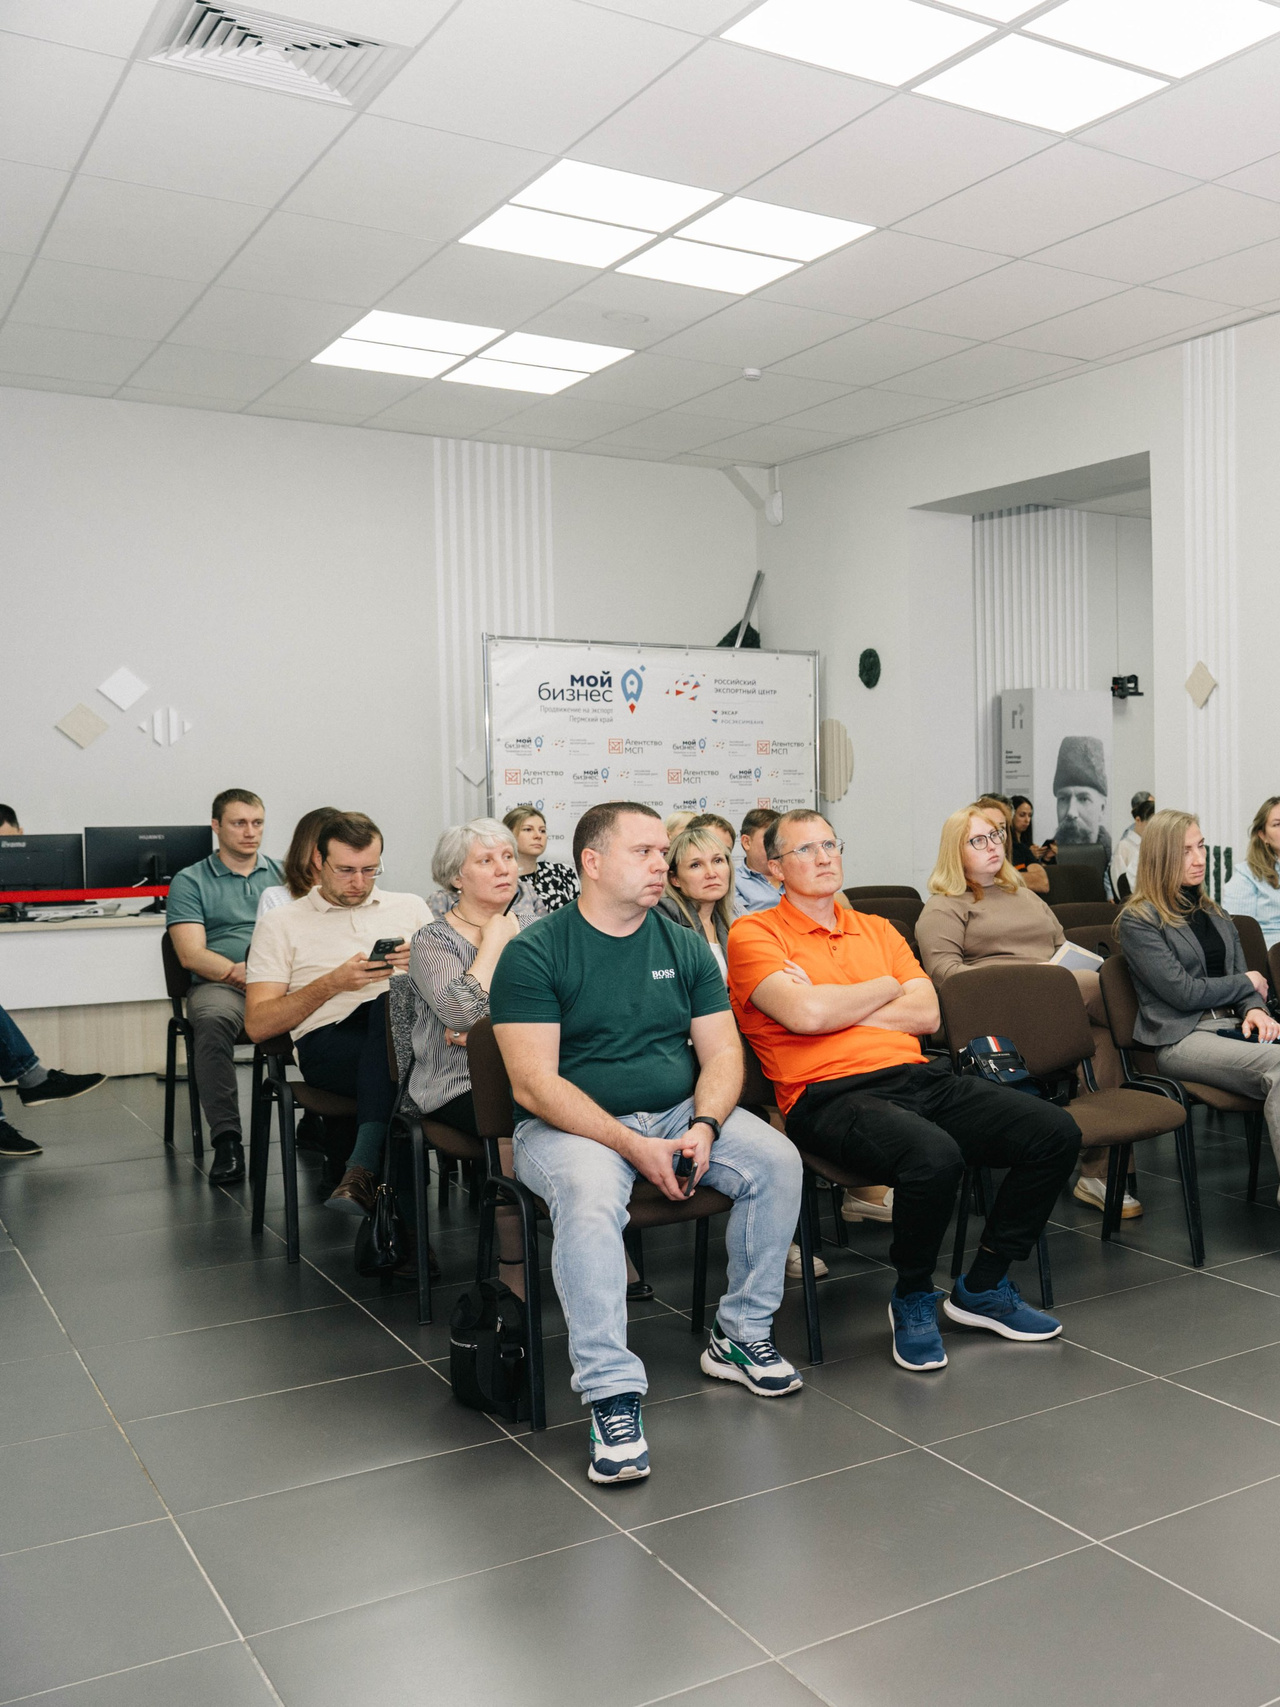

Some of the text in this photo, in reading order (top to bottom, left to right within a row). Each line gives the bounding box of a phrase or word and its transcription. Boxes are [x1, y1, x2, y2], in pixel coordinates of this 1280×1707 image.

[570, 670, 612, 688] мой
[538, 682, 613, 702] бизнес
[540, 705, 582, 714] Продвижение
[591, 707, 614, 715] экспорт
[569, 715, 614, 724] Пермский край
[624, 738, 663, 747] Агентство
[772, 740, 805, 748] Агентство
[624, 746, 644, 754] МСП
[771, 748, 788, 756] МСП
[523, 769, 564, 777] Агентство
[522, 778, 544, 786] МСП
[682, 776, 702, 784] МСП
[772, 798, 806, 806] Агентство
[652, 968, 676, 978] BOSS
